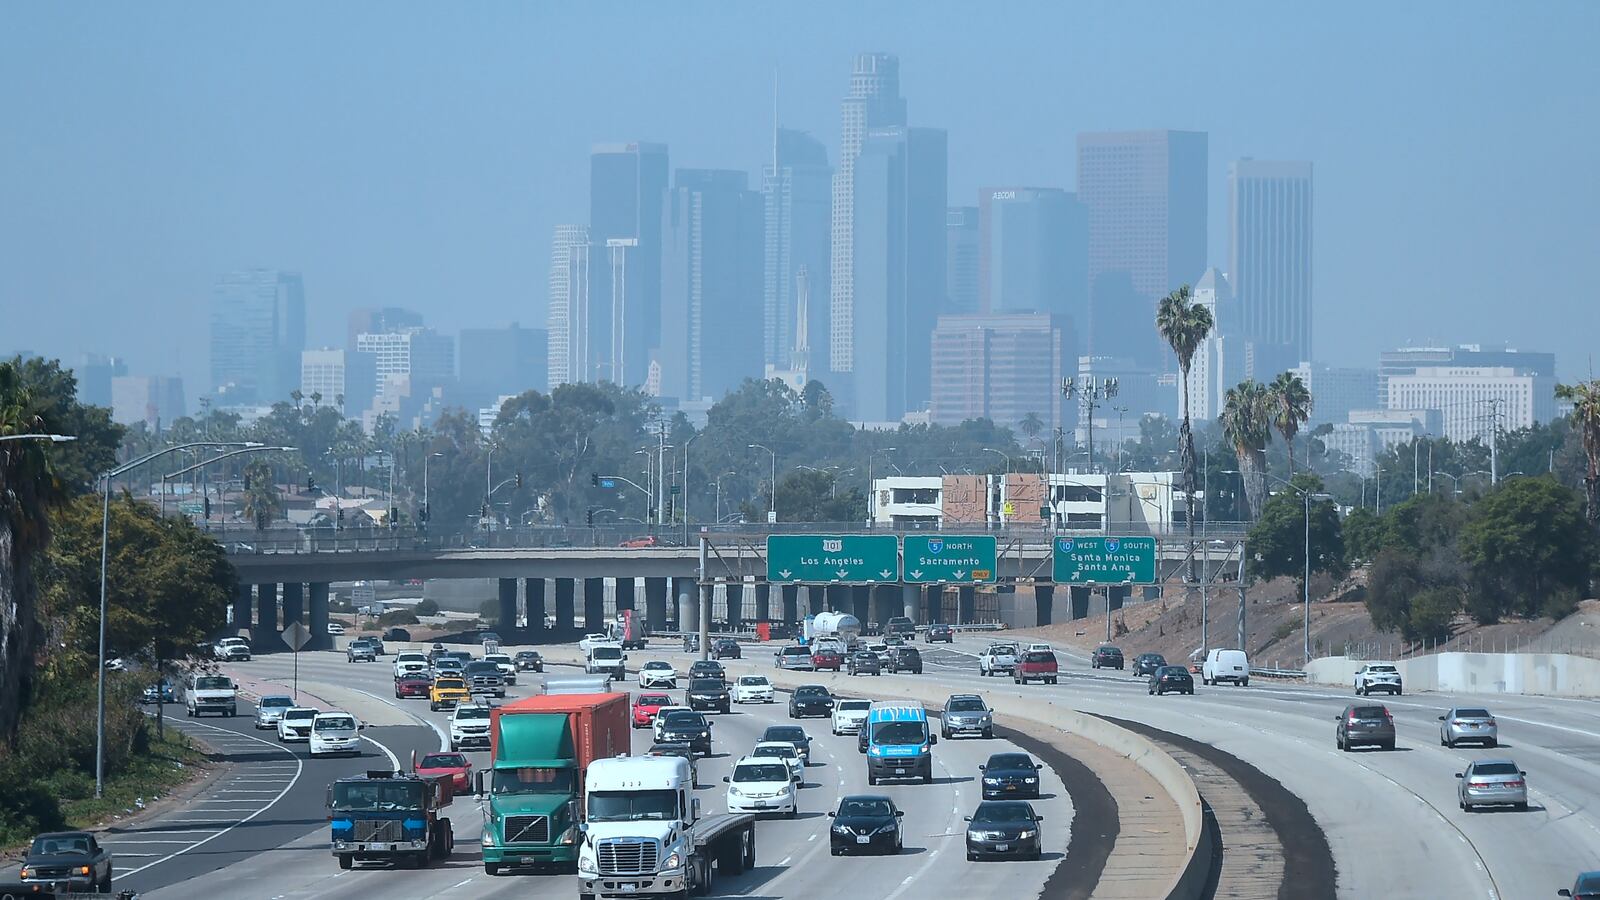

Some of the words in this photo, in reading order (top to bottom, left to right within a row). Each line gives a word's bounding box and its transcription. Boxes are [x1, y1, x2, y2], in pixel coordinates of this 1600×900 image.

[992, 192, 1016, 200] AECOM
[919, 557, 980, 565] Sacramento
[1071, 553, 1101, 561] Santa
[824, 557, 864, 567] Angeles
